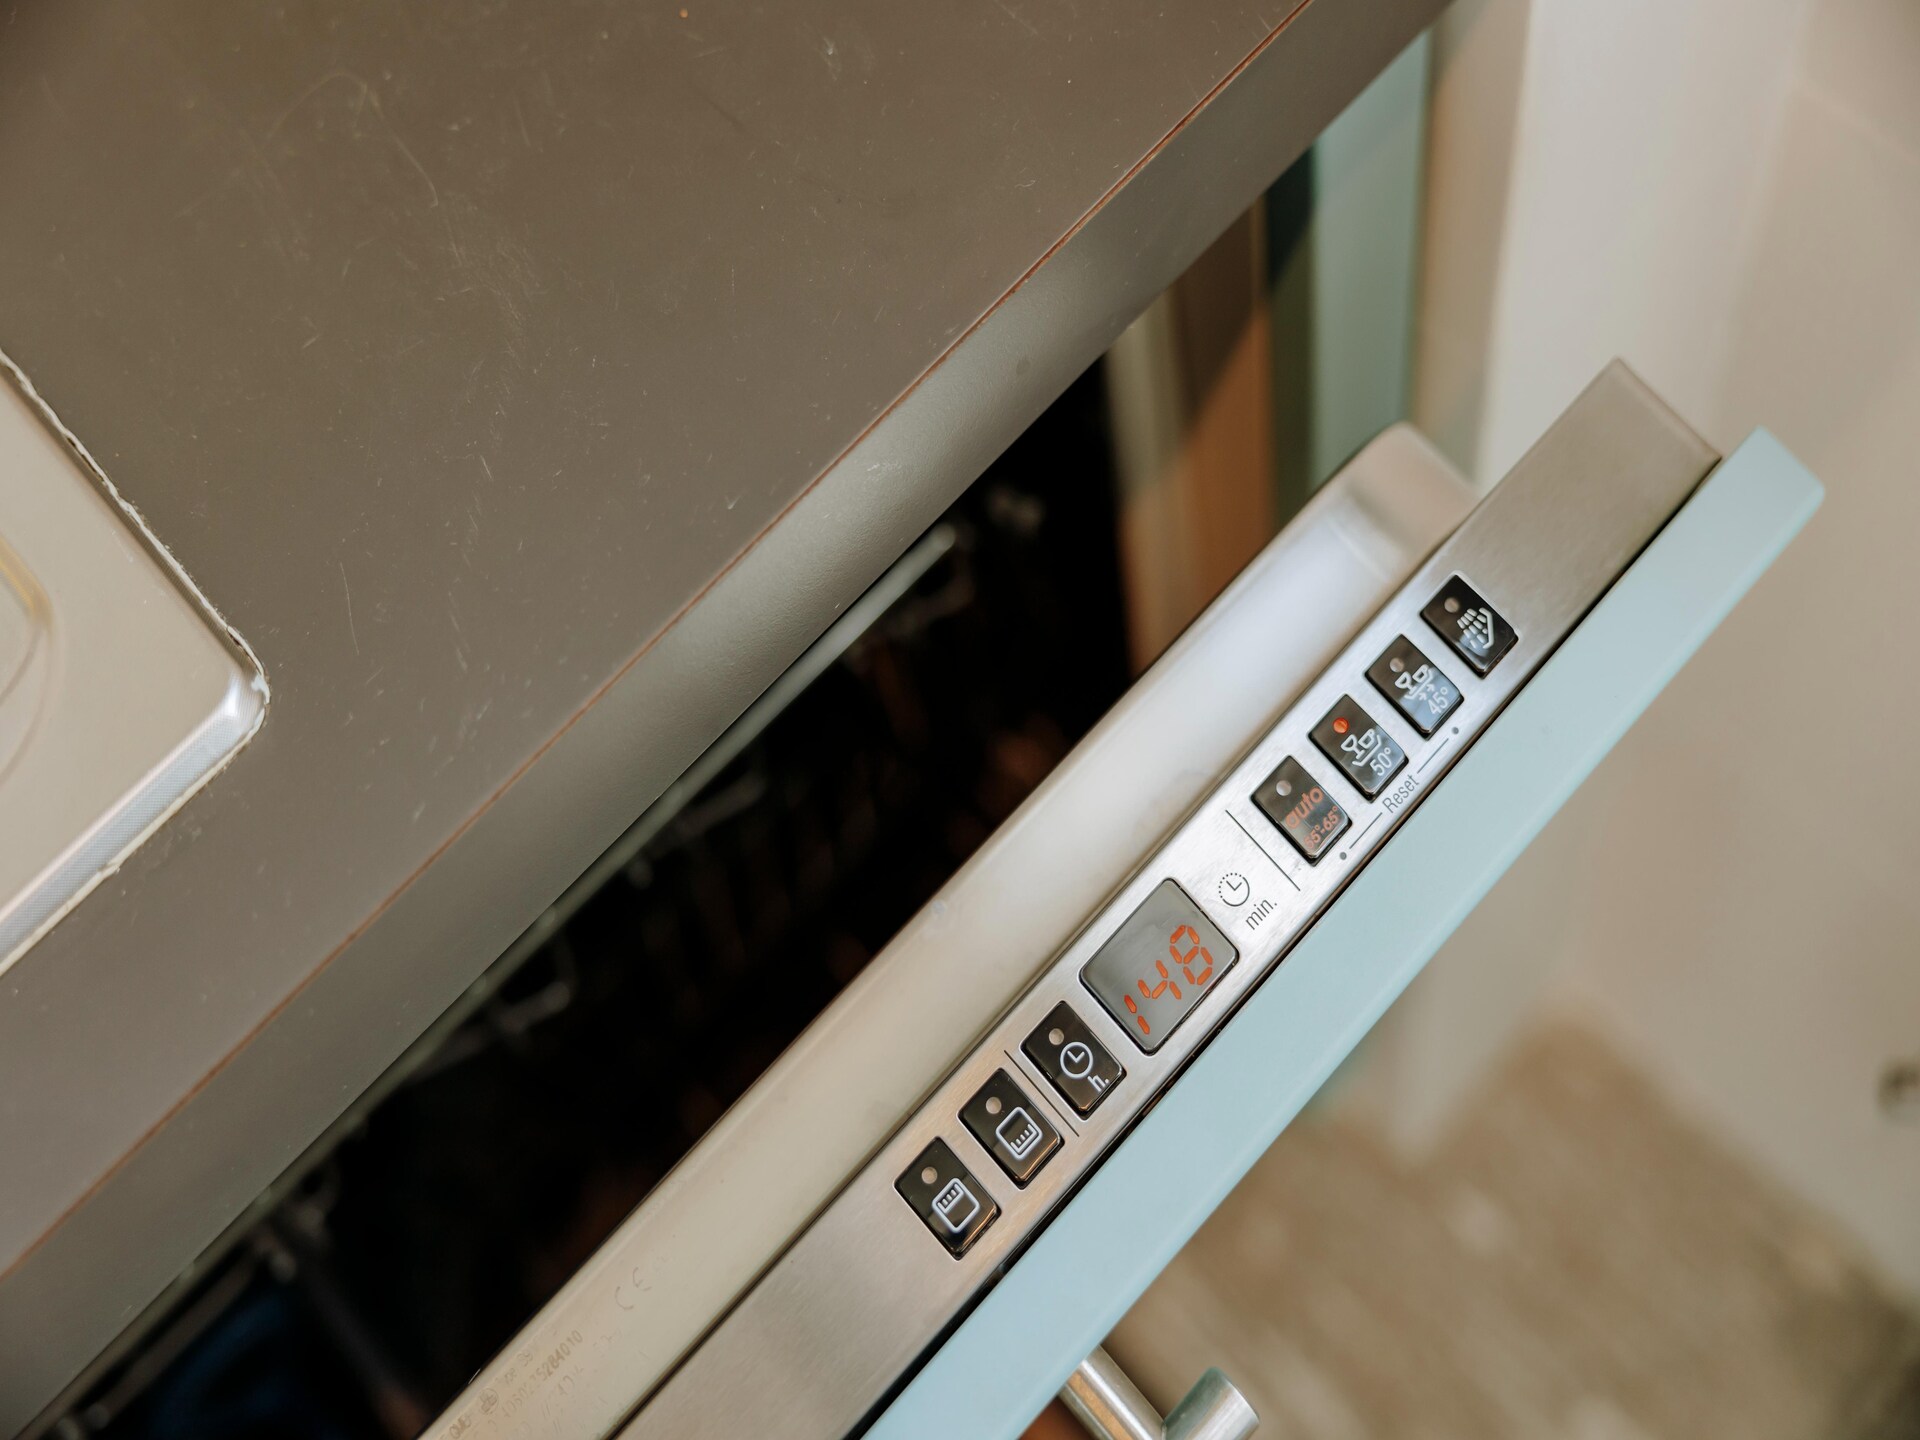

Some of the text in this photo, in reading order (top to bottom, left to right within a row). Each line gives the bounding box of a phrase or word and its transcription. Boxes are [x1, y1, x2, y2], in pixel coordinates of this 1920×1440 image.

[1427, 686, 1449, 714] 45°
[1370, 747, 1392, 776] 50°
[1285, 786, 1324, 829] auto
[1382, 773, 1420, 814] Reset
[1245, 899, 1278, 931] min.
[1123, 925, 1214, 1035] 148
